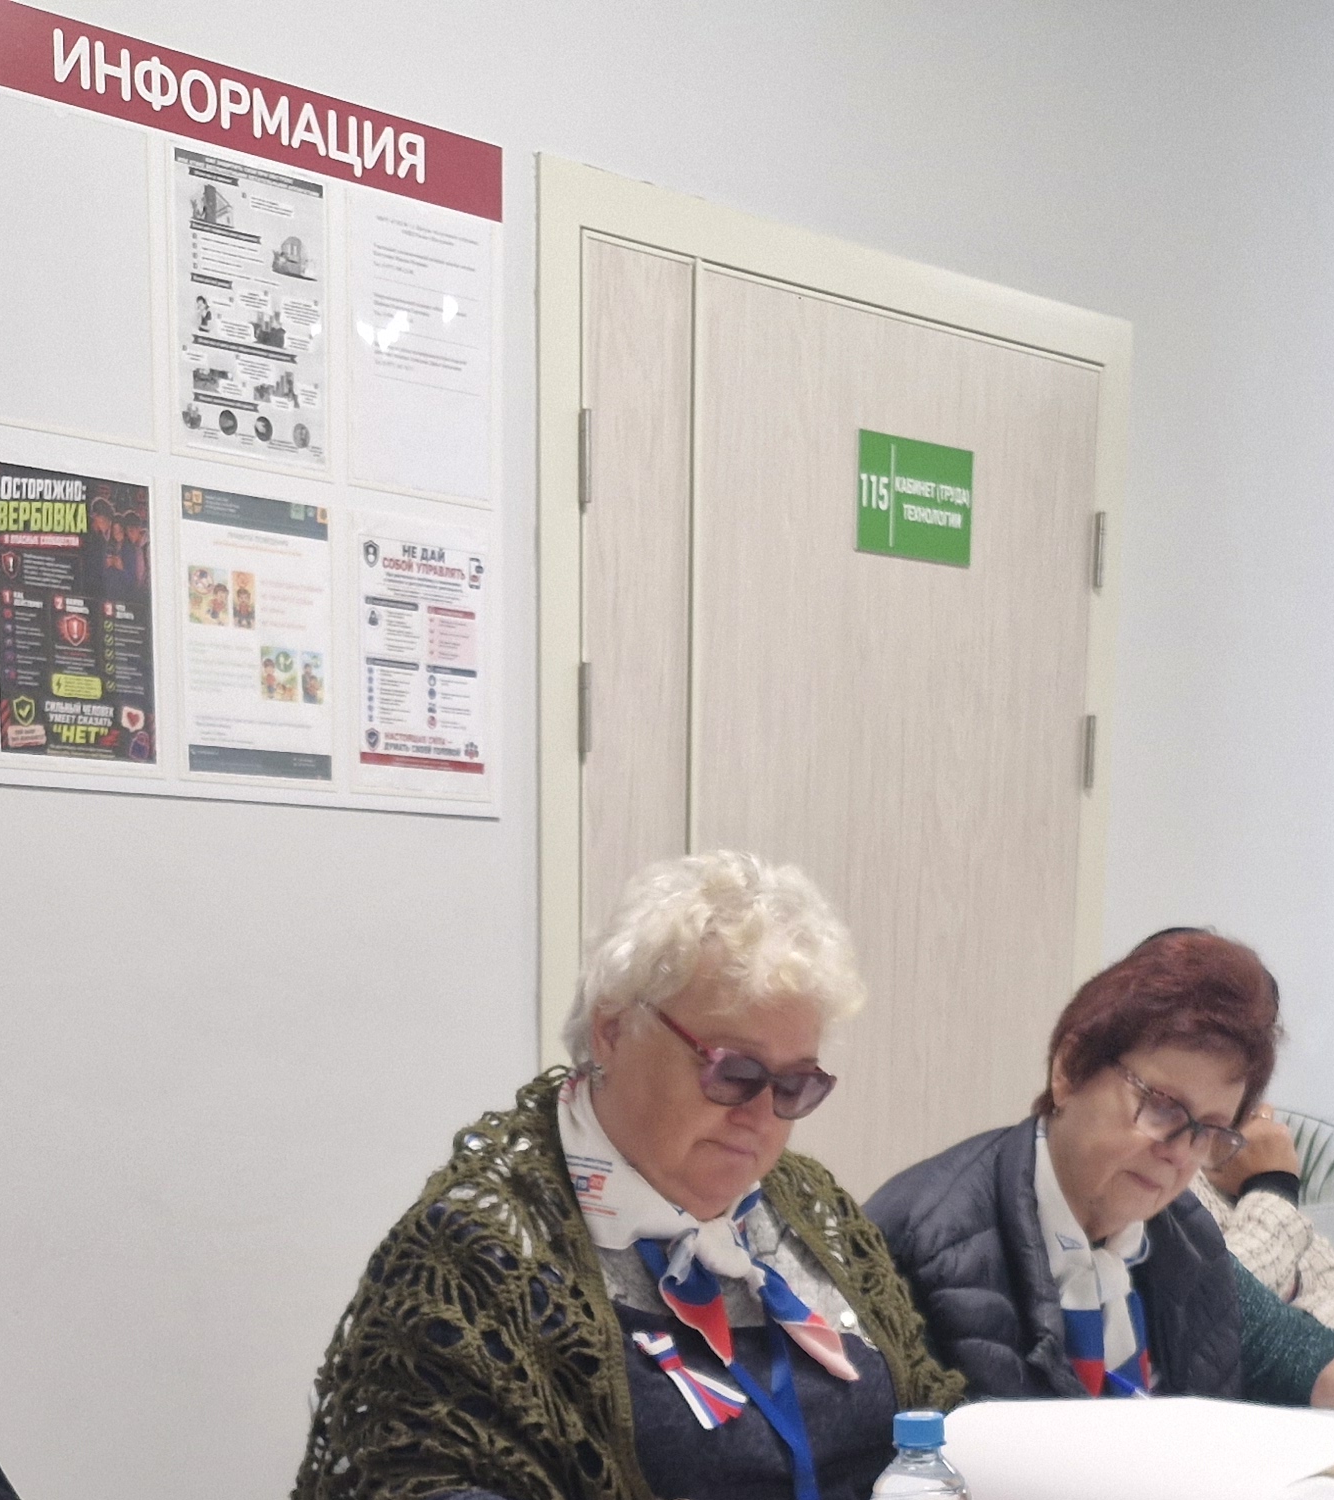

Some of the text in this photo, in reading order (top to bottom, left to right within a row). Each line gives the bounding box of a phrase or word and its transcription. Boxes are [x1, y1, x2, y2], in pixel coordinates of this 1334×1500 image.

[52, 27, 426, 184] ИНФОРМАЦИЯ
[0, 475, 87, 501] ОСТОРОЖНО:
[860, 473, 889, 511] 115
[895, 476, 936, 498] КАБИНЕТ
[402, 545, 418, 559] НЕ
